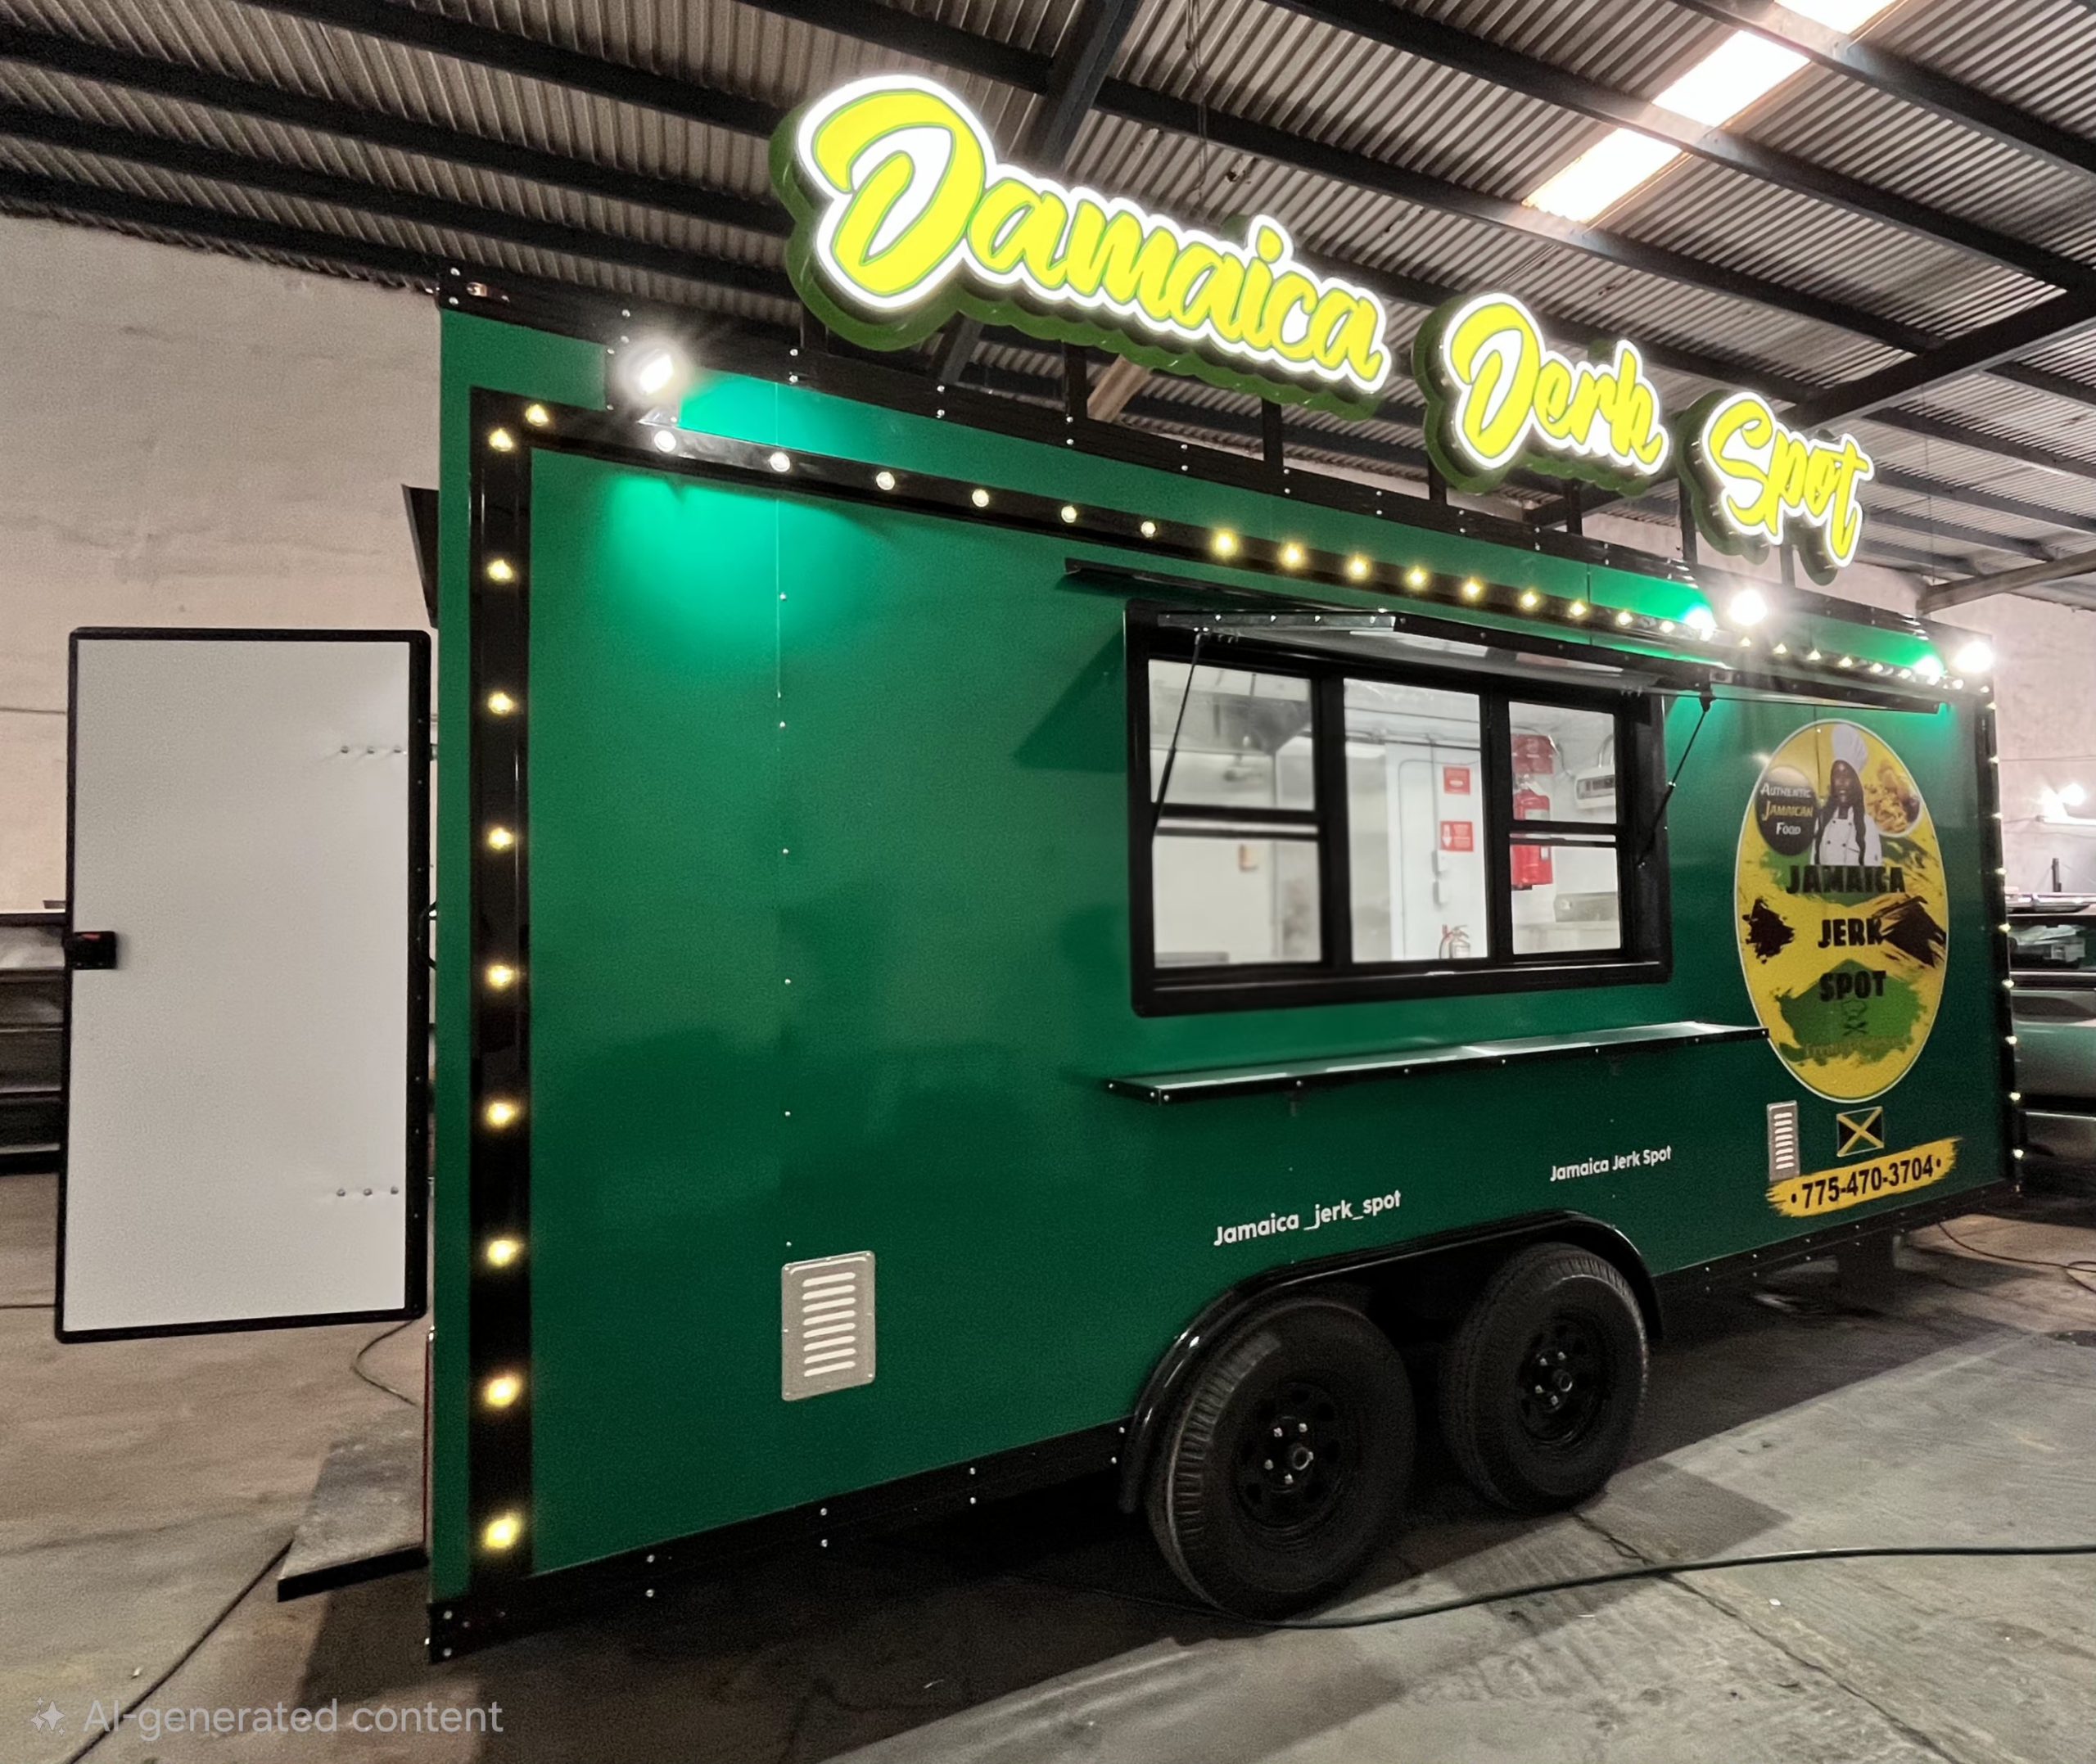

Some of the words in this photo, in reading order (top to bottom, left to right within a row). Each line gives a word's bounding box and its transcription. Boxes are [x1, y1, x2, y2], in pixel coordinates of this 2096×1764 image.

[1708, 399, 1870, 560] Spot
[1786, 865, 1905, 894] JAMAICA
[1817, 918, 1884, 949] JERK
[1818, 971, 1886, 1002] SPOT
[1550, 1157, 1609, 1182] Jamaica
[1612, 1150, 1641, 1171] Jerk
[1643, 1145, 1672, 1166] Spot
[1802, 1155, 1933, 1209] 775-470-3704
